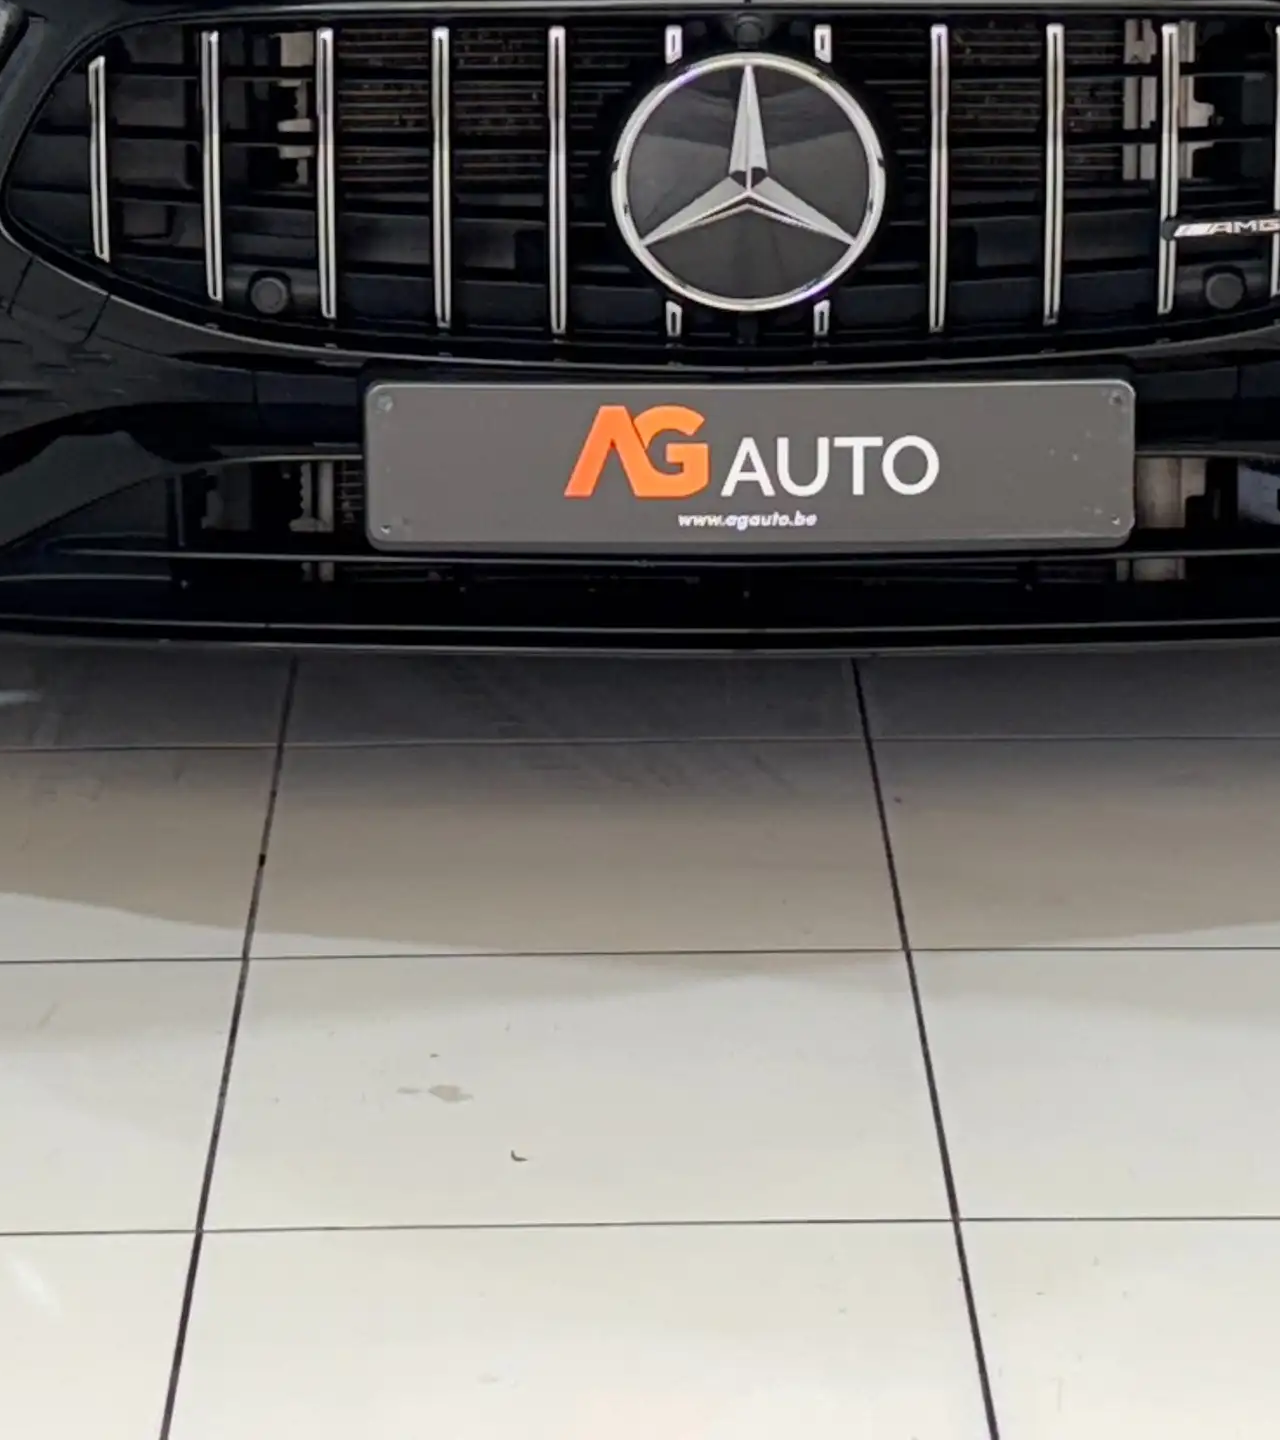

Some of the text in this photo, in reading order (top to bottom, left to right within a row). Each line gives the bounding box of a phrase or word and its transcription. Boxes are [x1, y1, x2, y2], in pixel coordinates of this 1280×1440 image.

[565, 404, 940, 498] AG AUTO
[678, 510, 818, 531] www.agauto.be
